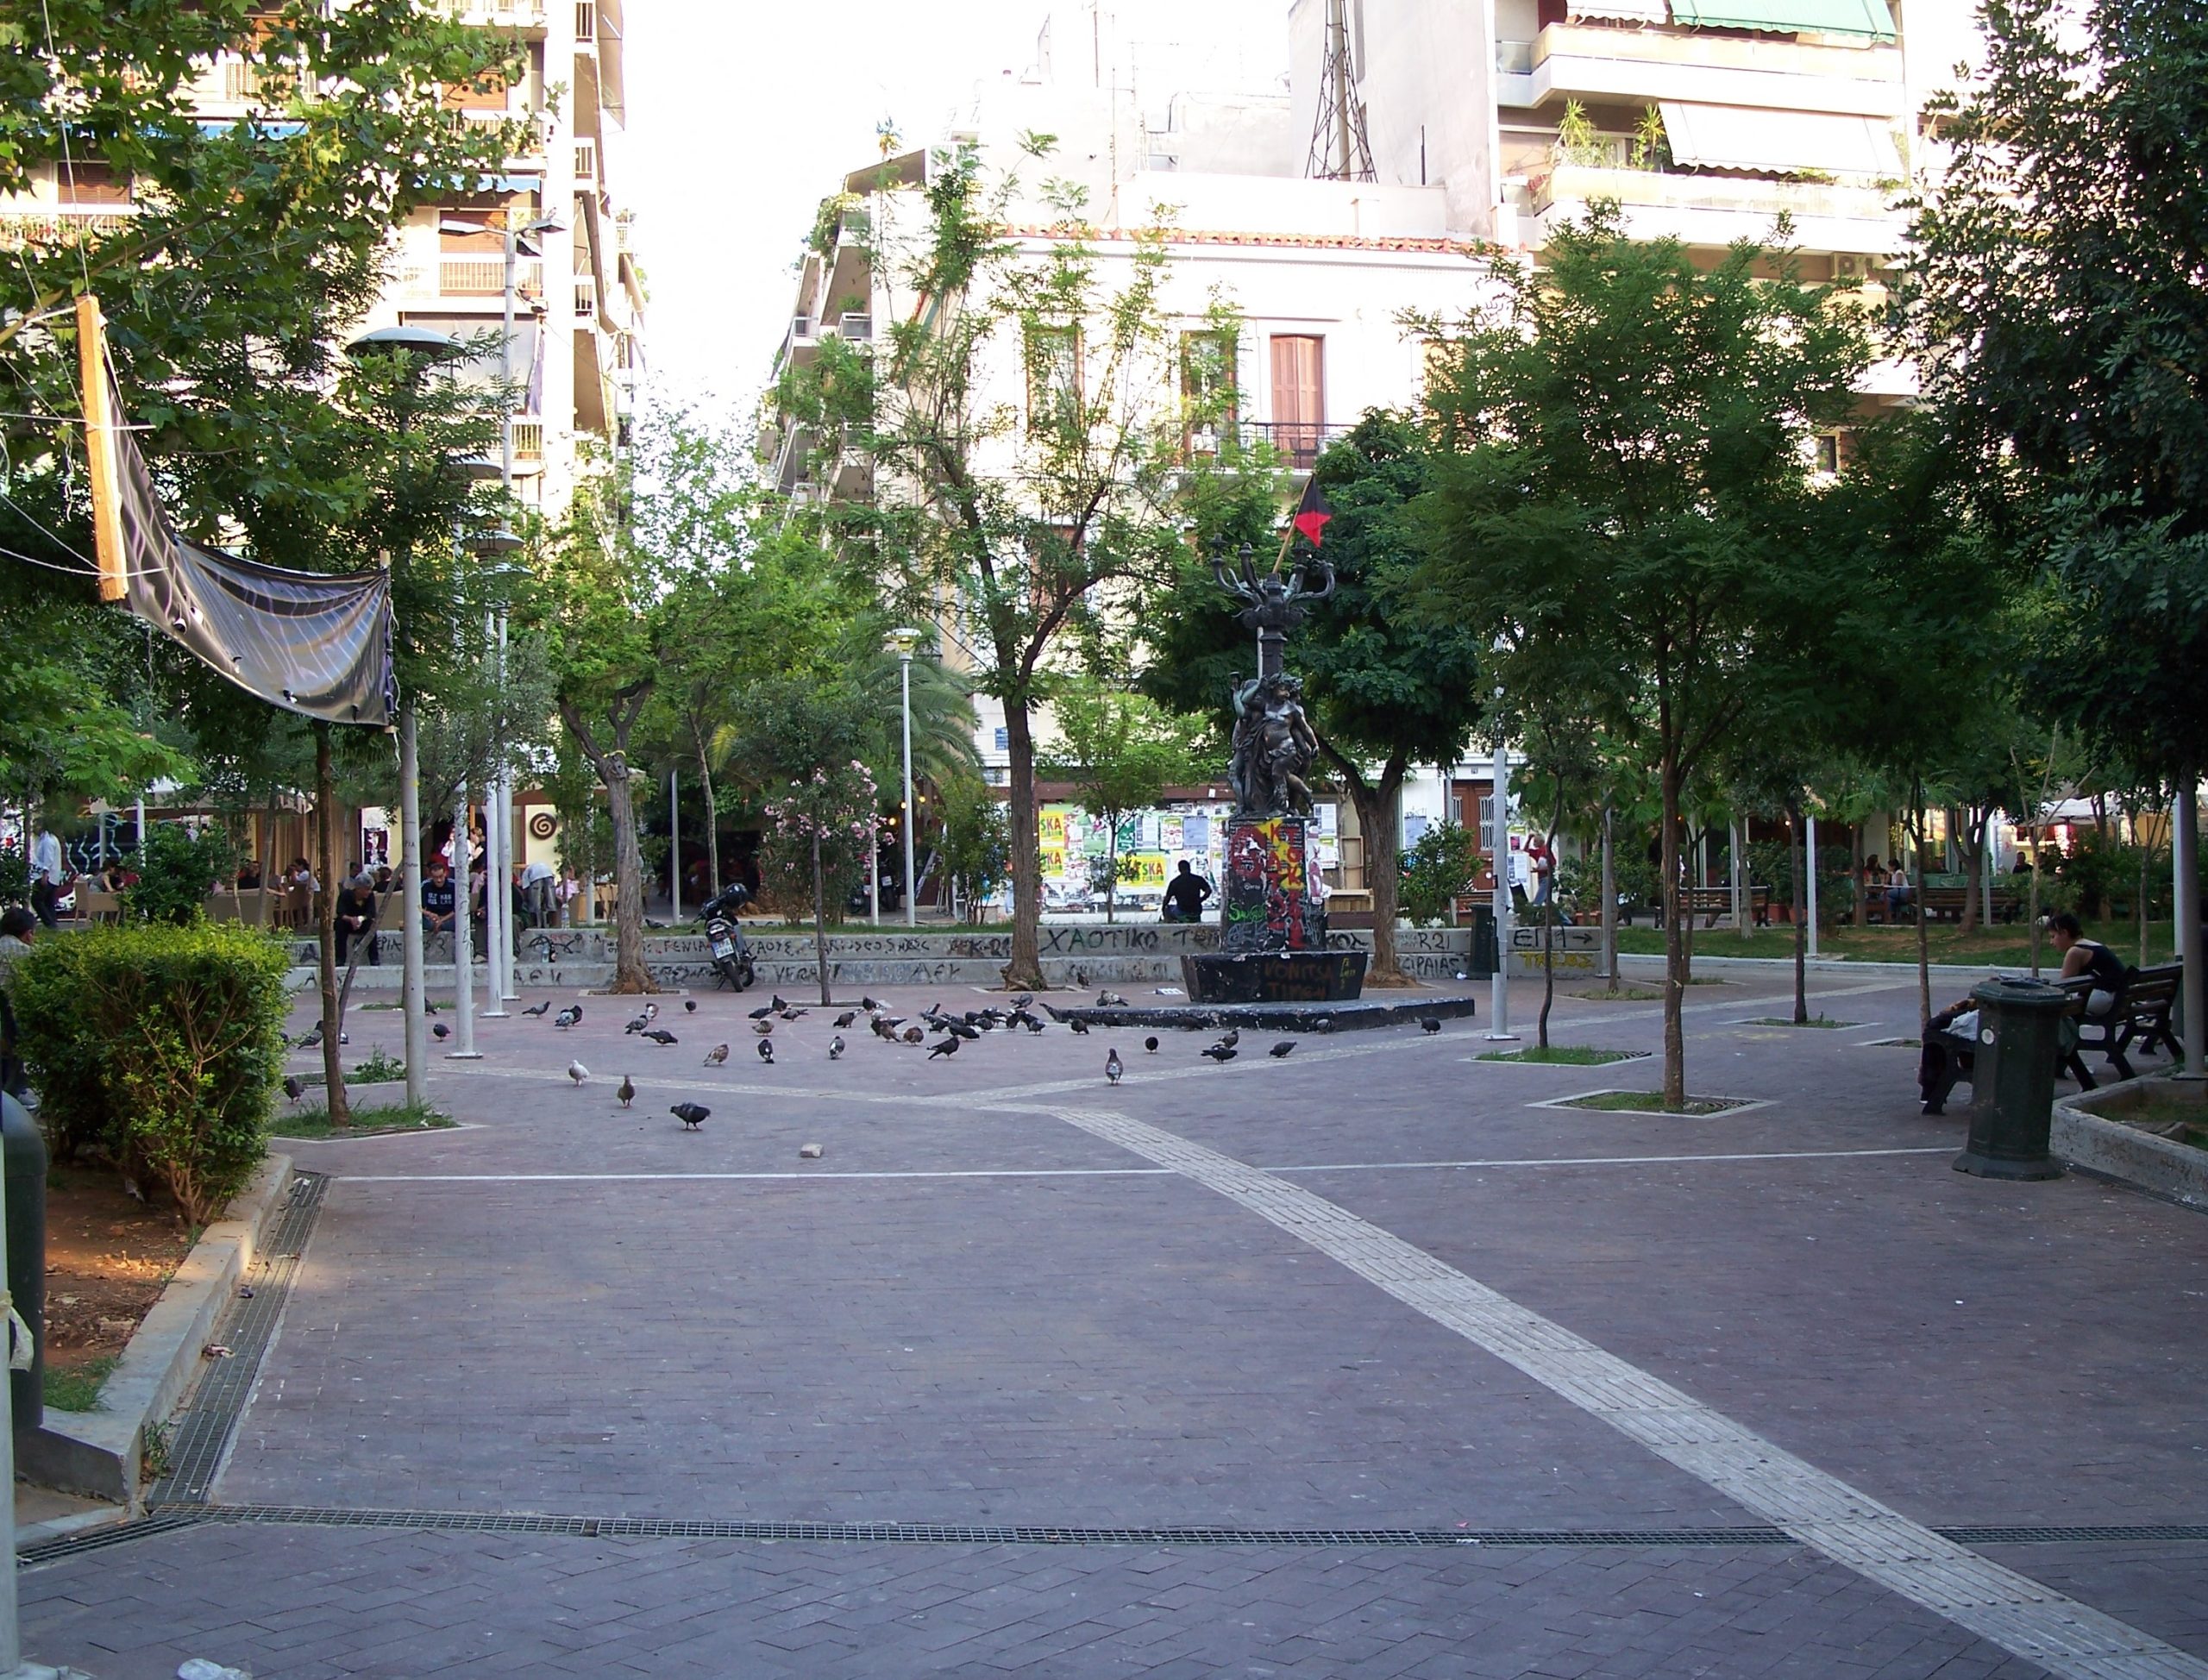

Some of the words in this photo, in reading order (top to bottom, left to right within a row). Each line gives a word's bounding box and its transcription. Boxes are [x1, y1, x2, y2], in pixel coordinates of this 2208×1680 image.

[1040, 818, 1062, 831] SKA
[1040, 851, 1062, 865] SKA
[1142, 862, 1164, 875] SKA
